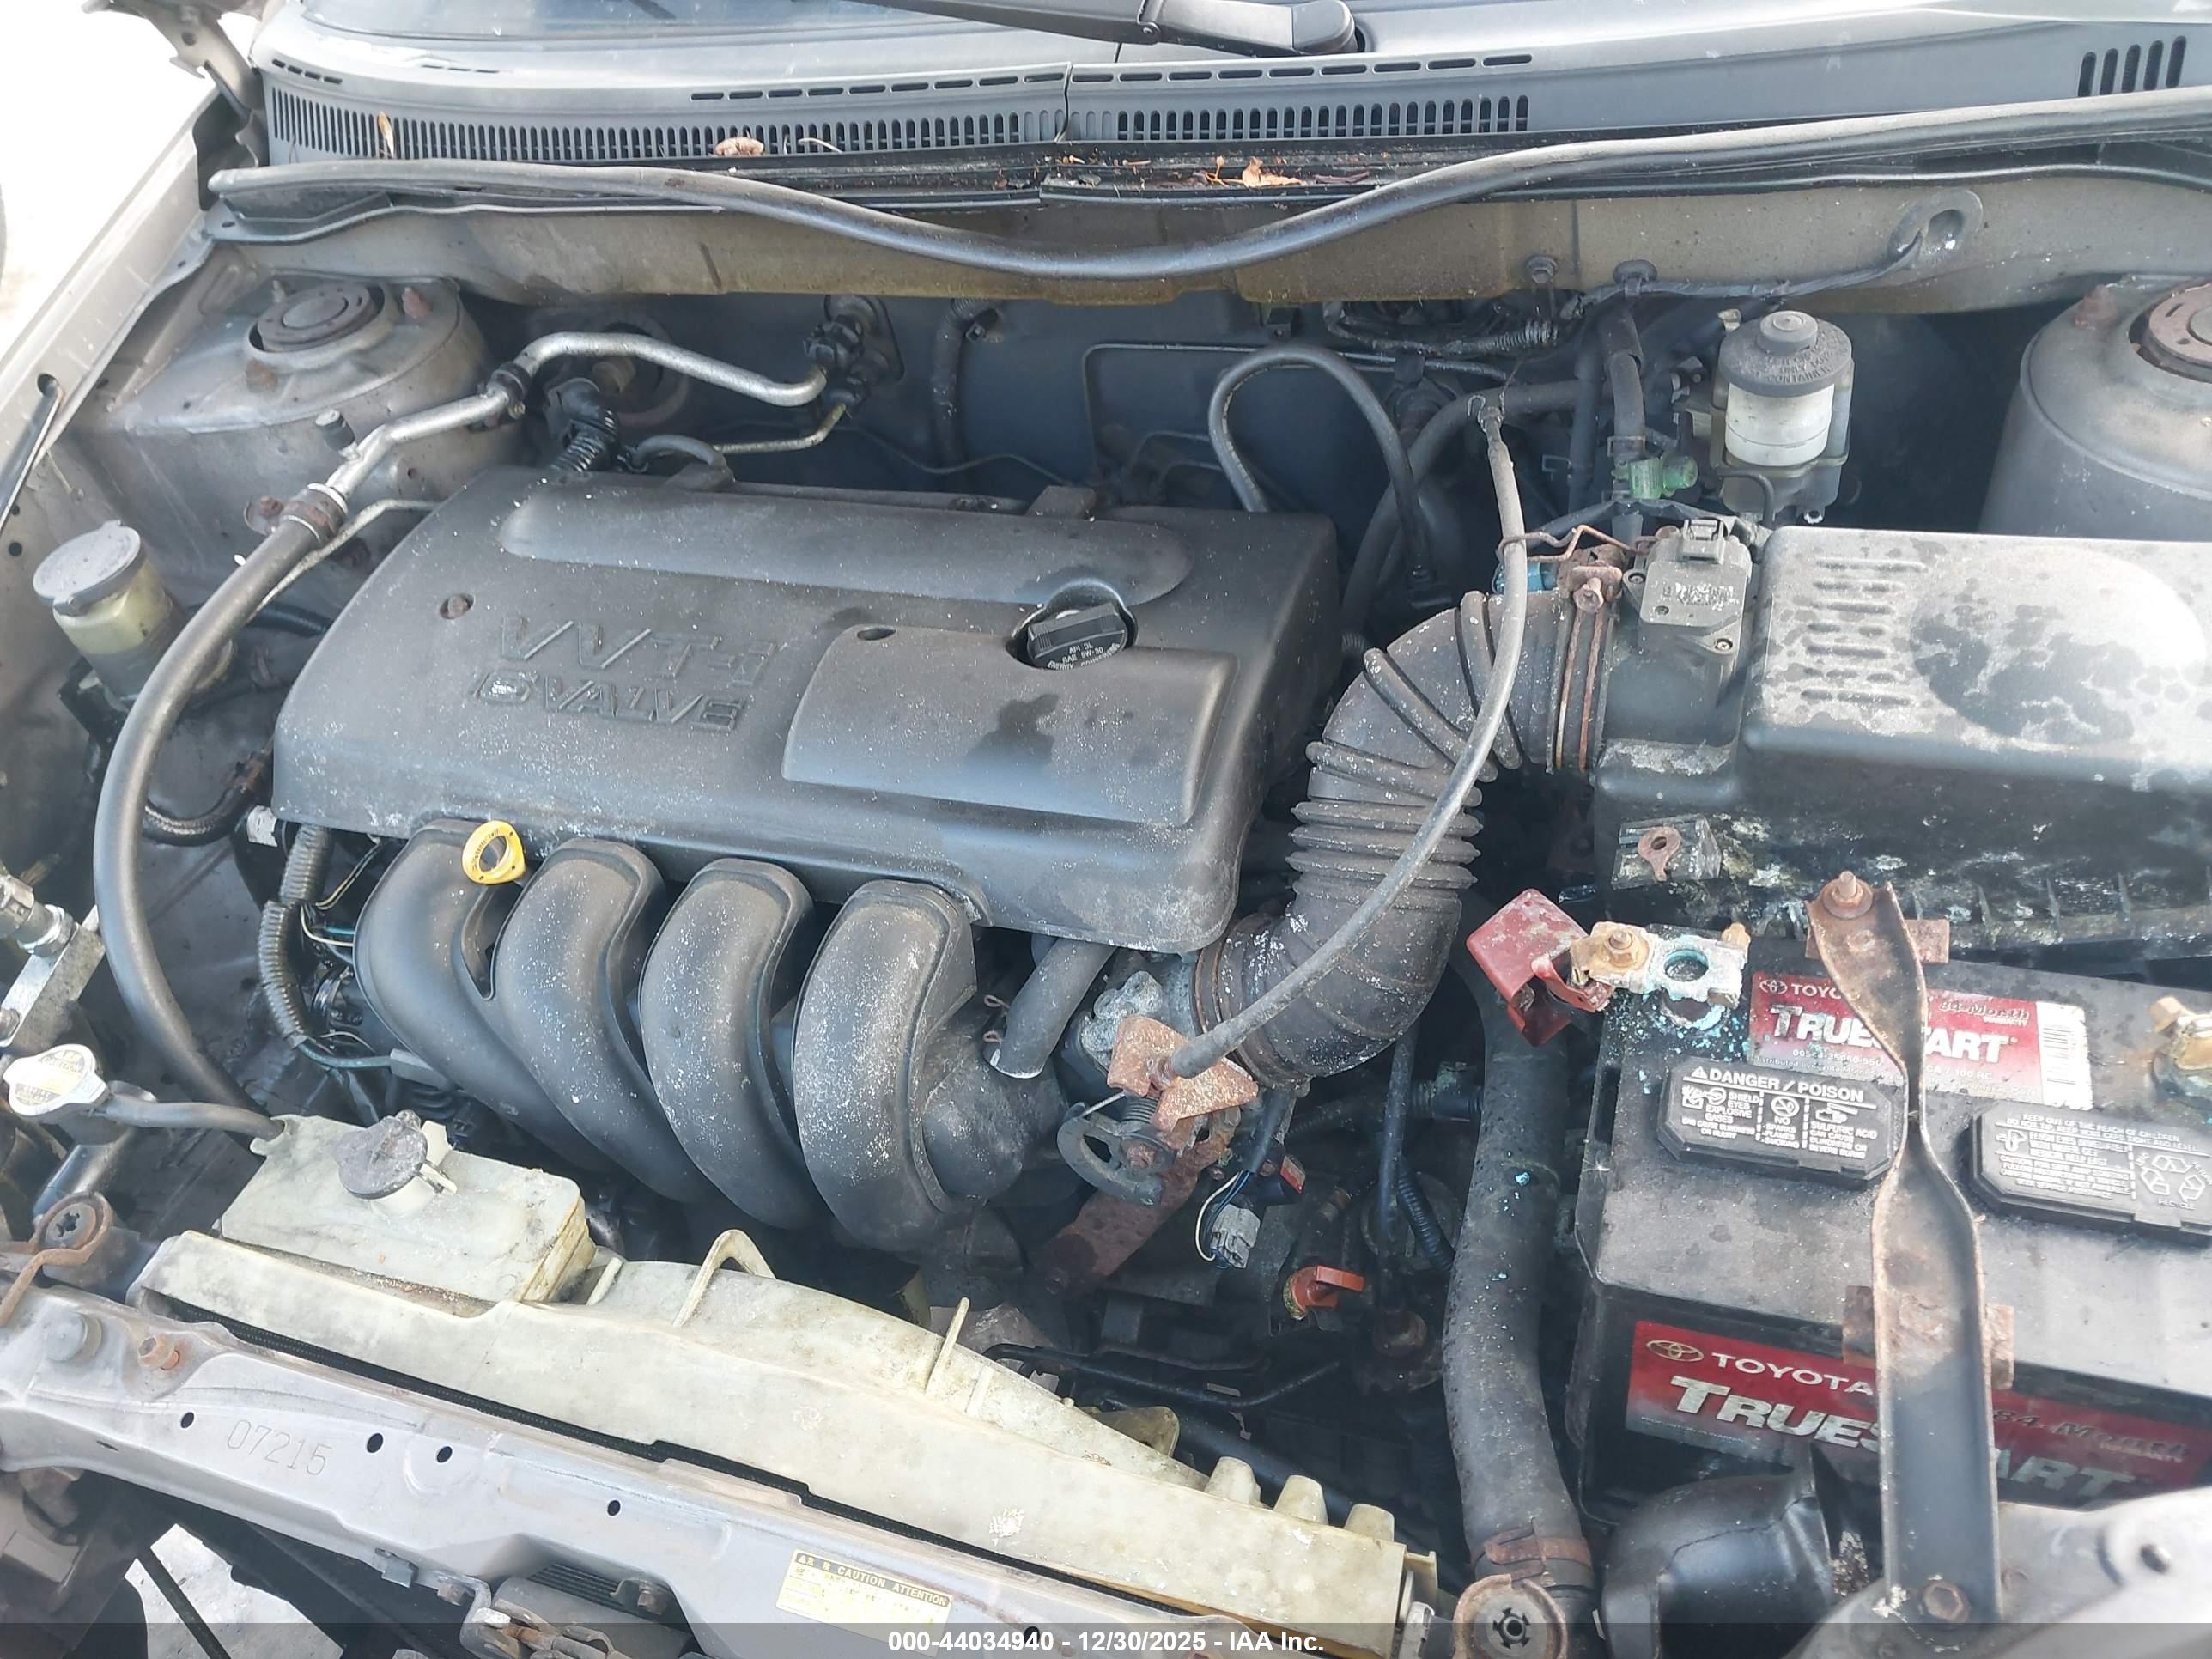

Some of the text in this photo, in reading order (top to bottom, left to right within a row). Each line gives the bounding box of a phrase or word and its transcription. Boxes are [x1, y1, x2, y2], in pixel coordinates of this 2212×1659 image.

[1791, 983, 1842, 1000] TOYO
[1710, 1069, 1780, 1090] DANGER
[1797, 1084, 1864, 1103] POISON
[1728, 1100, 1751, 1109] EYES
[1729, 1091, 1759, 1103] SHIELD
[1705, 1104, 1753, 1119] EXPLOSIVE
[1705, 1113, 1735, 1124] GASES
[1774, 1115, 1792, 1126] NO
[1855, 1128, 1878, 1140] ACID
[1711, 1352, 1874, 1395] TOYOTA
[227, 1419, 332, 1475] 07215
[837, 1567, 886, 1588] CAUTION
[892, 1583, 949, 1607] ATTENTION
